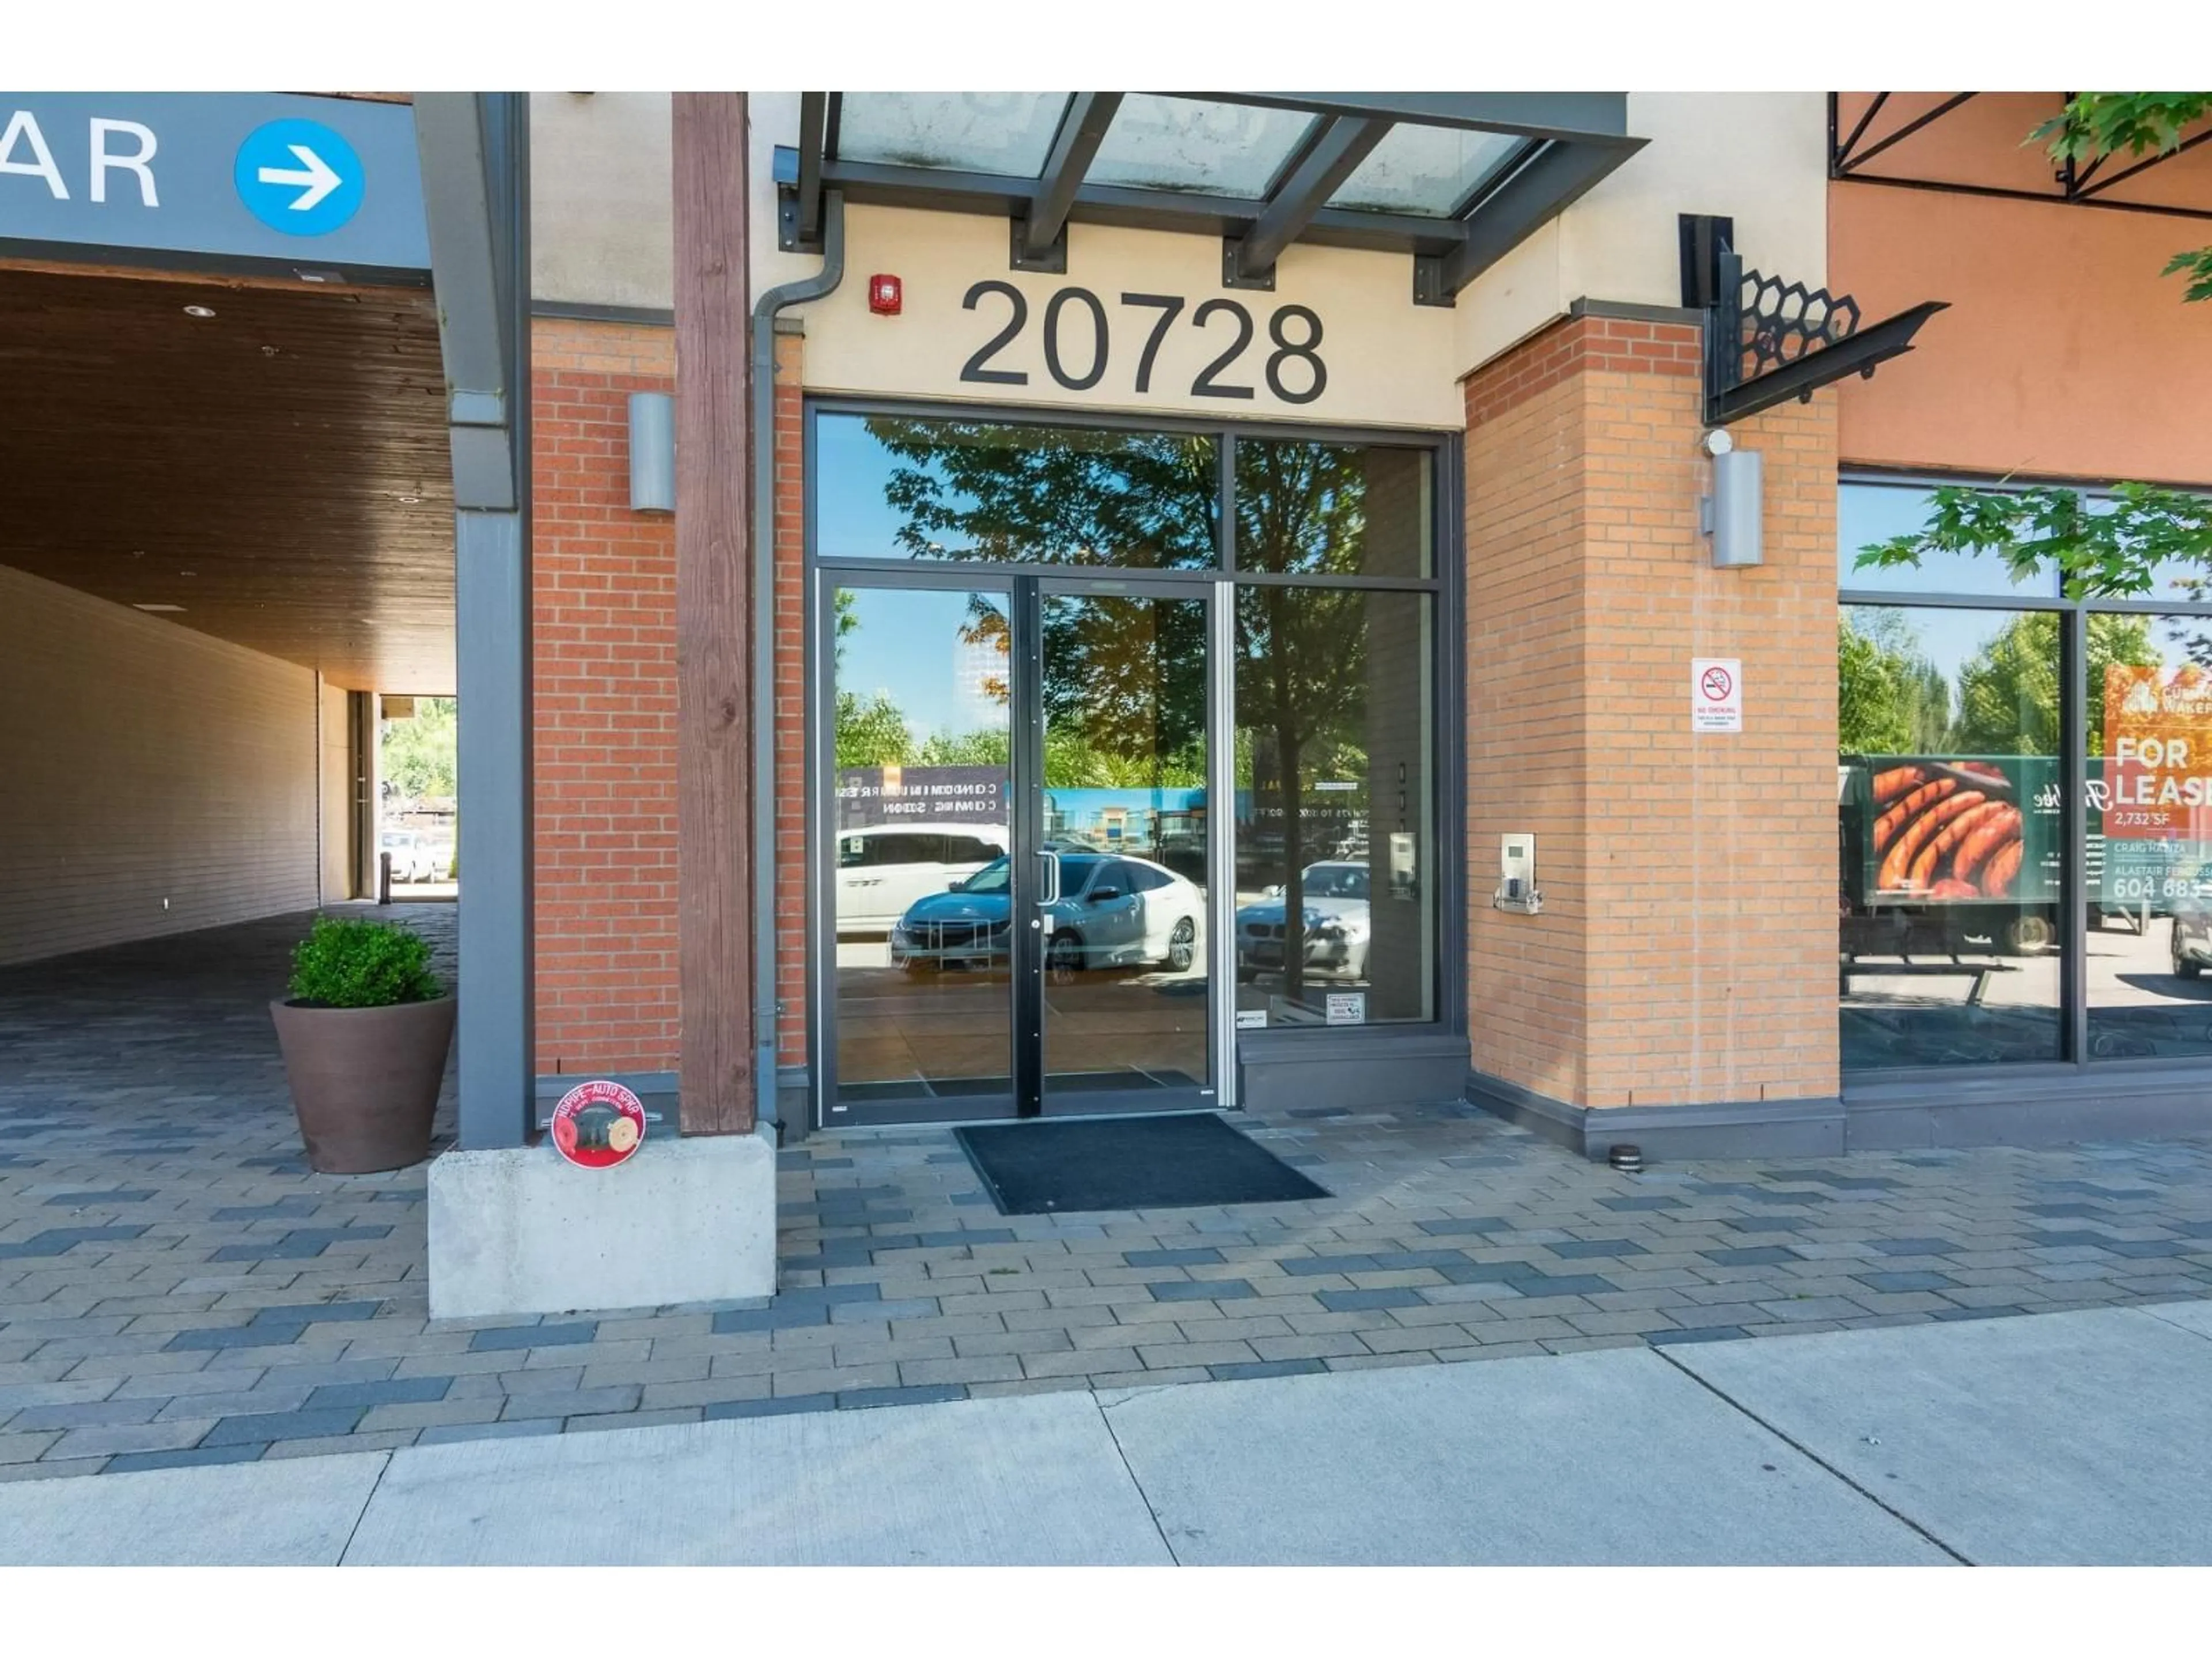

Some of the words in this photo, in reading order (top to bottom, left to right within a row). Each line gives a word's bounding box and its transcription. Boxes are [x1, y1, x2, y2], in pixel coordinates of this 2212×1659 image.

[0, 111, 160, 207] AR
[959, 281, 1328, 404] 20728
[2116, 737, 2187, 768] FOR
[2115, 812, 2149, 827] 2,732
[2152, 812, 2170, 825] SF
[2115, 865, 2163, 876] ALASTAIR
[2113, 877, 2156, 898] 604
[2163, 877, 2201, 898] 683
